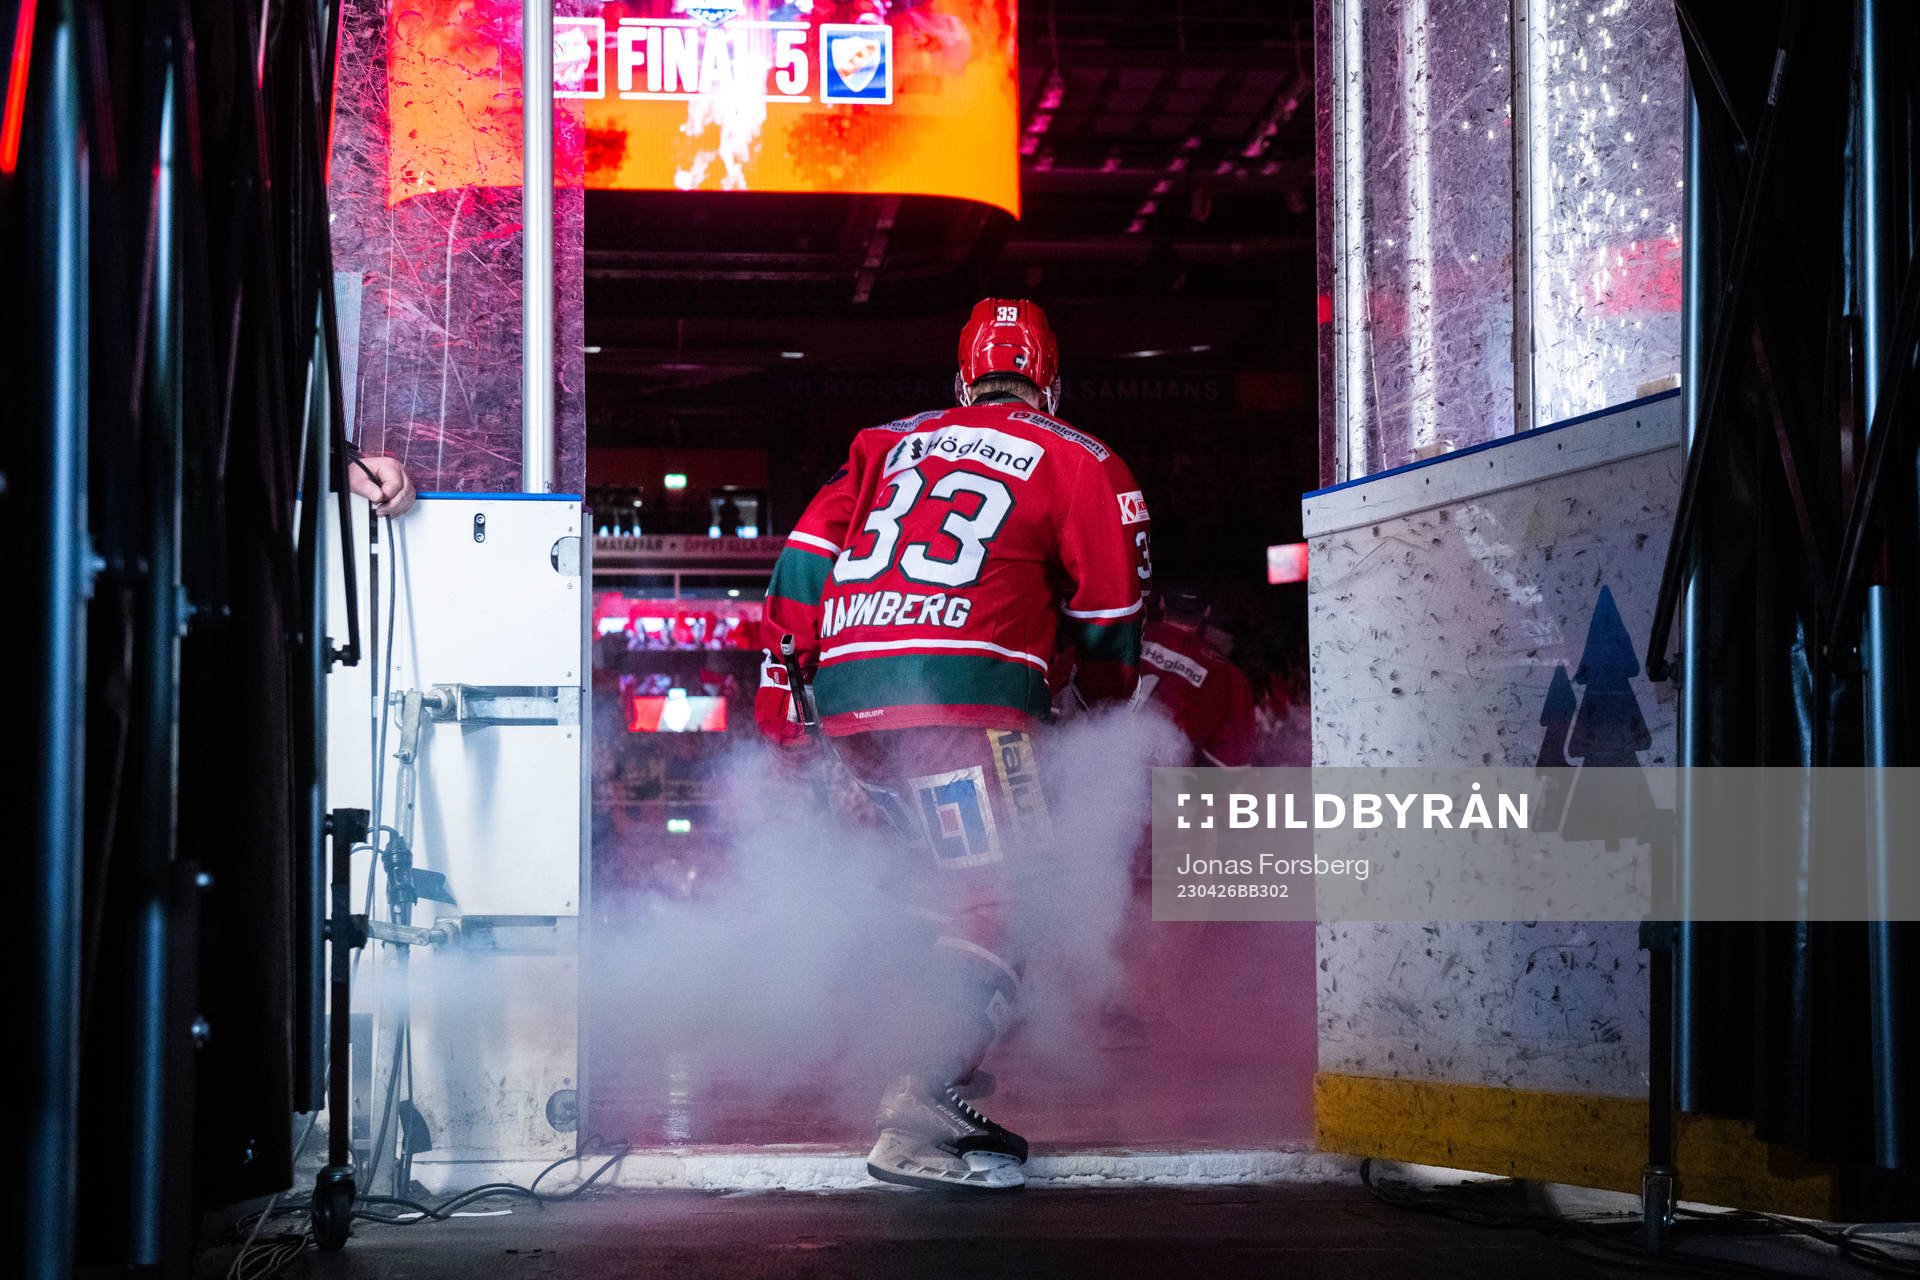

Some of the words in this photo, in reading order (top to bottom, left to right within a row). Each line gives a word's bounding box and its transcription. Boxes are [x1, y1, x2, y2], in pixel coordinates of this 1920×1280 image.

[775, 29, 809, 95] 5
[997, 306, 1018, 321] 33
[926, 436, 1034, 472] Högland
[832, 467, 1016, 588] 33
[1135, 530, 1152, 580] 3
[1145, 647, 1203, 684] Högland
[858, 709, 884, 719] BAUER
